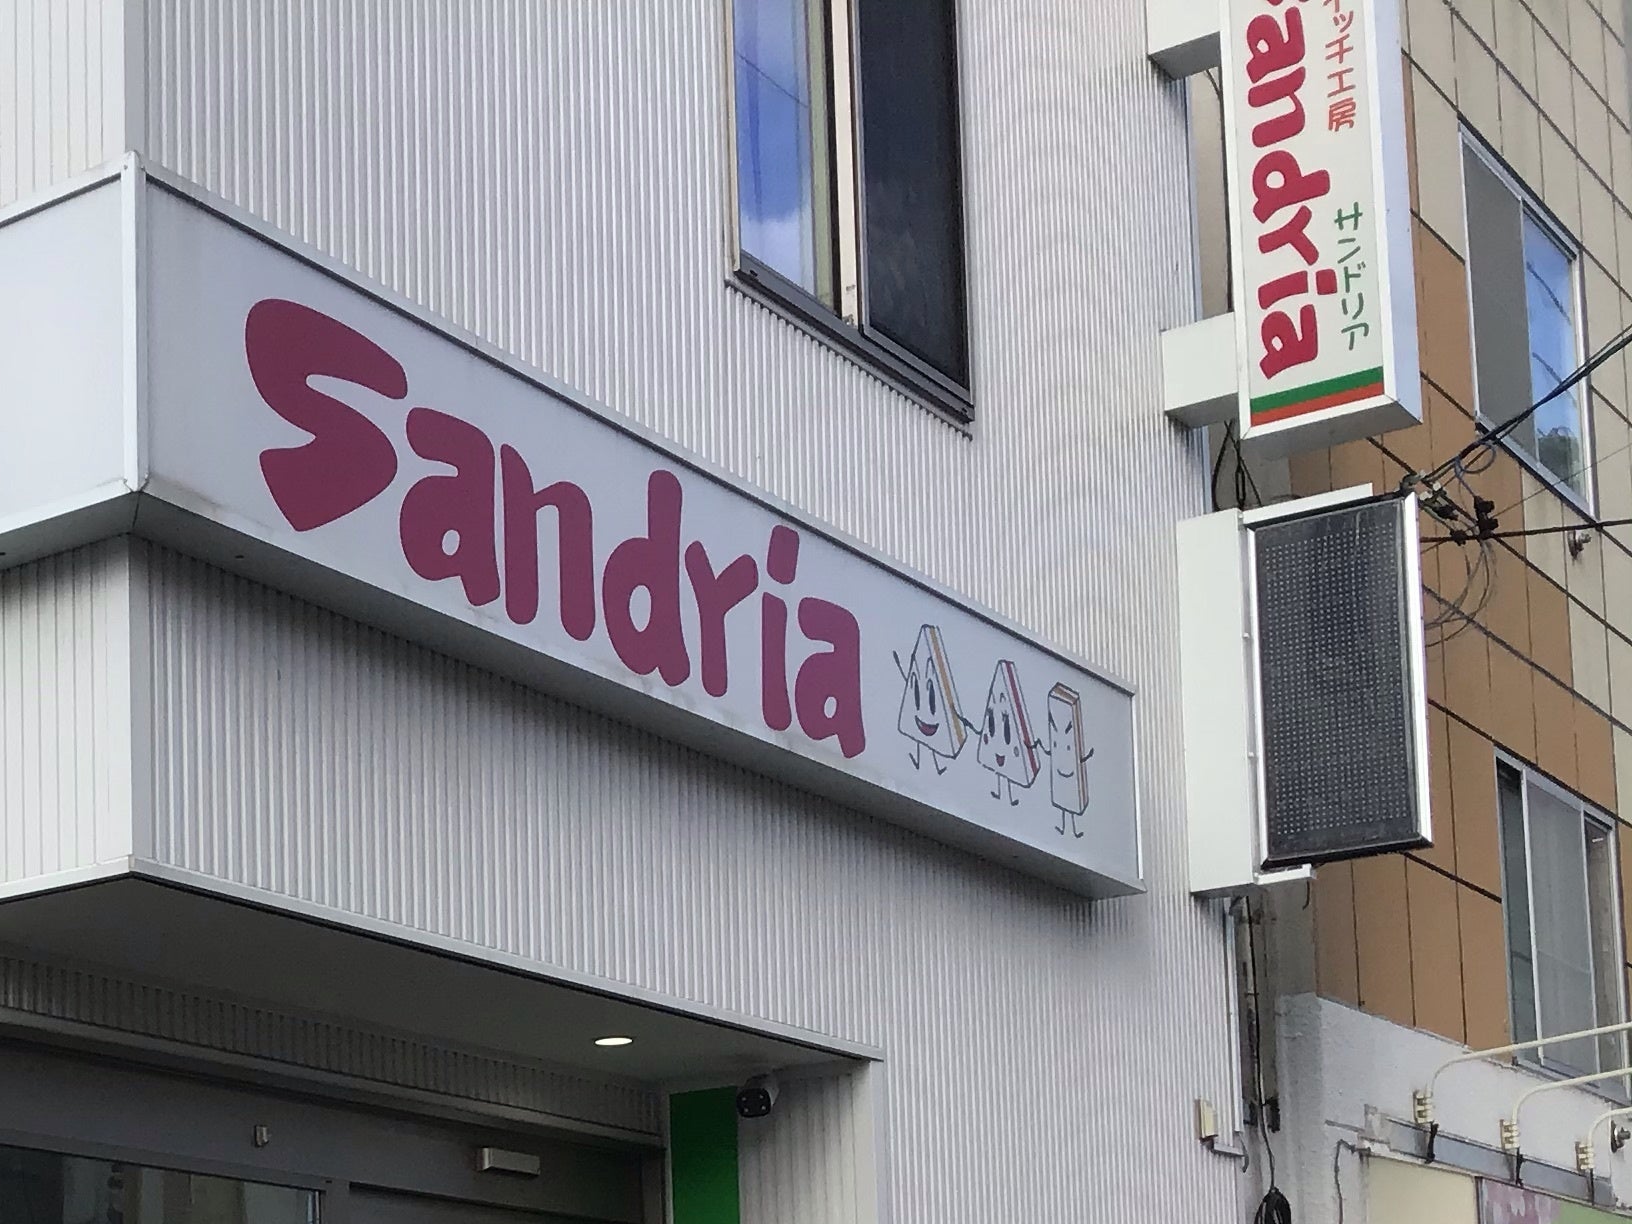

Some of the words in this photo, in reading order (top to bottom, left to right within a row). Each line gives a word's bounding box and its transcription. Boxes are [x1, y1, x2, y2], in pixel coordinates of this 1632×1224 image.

[1246, 0, 1338, 380] andria
[1334, 201, 1369, 351] サンドリア
[244, 298, 866, 759] Sandria
